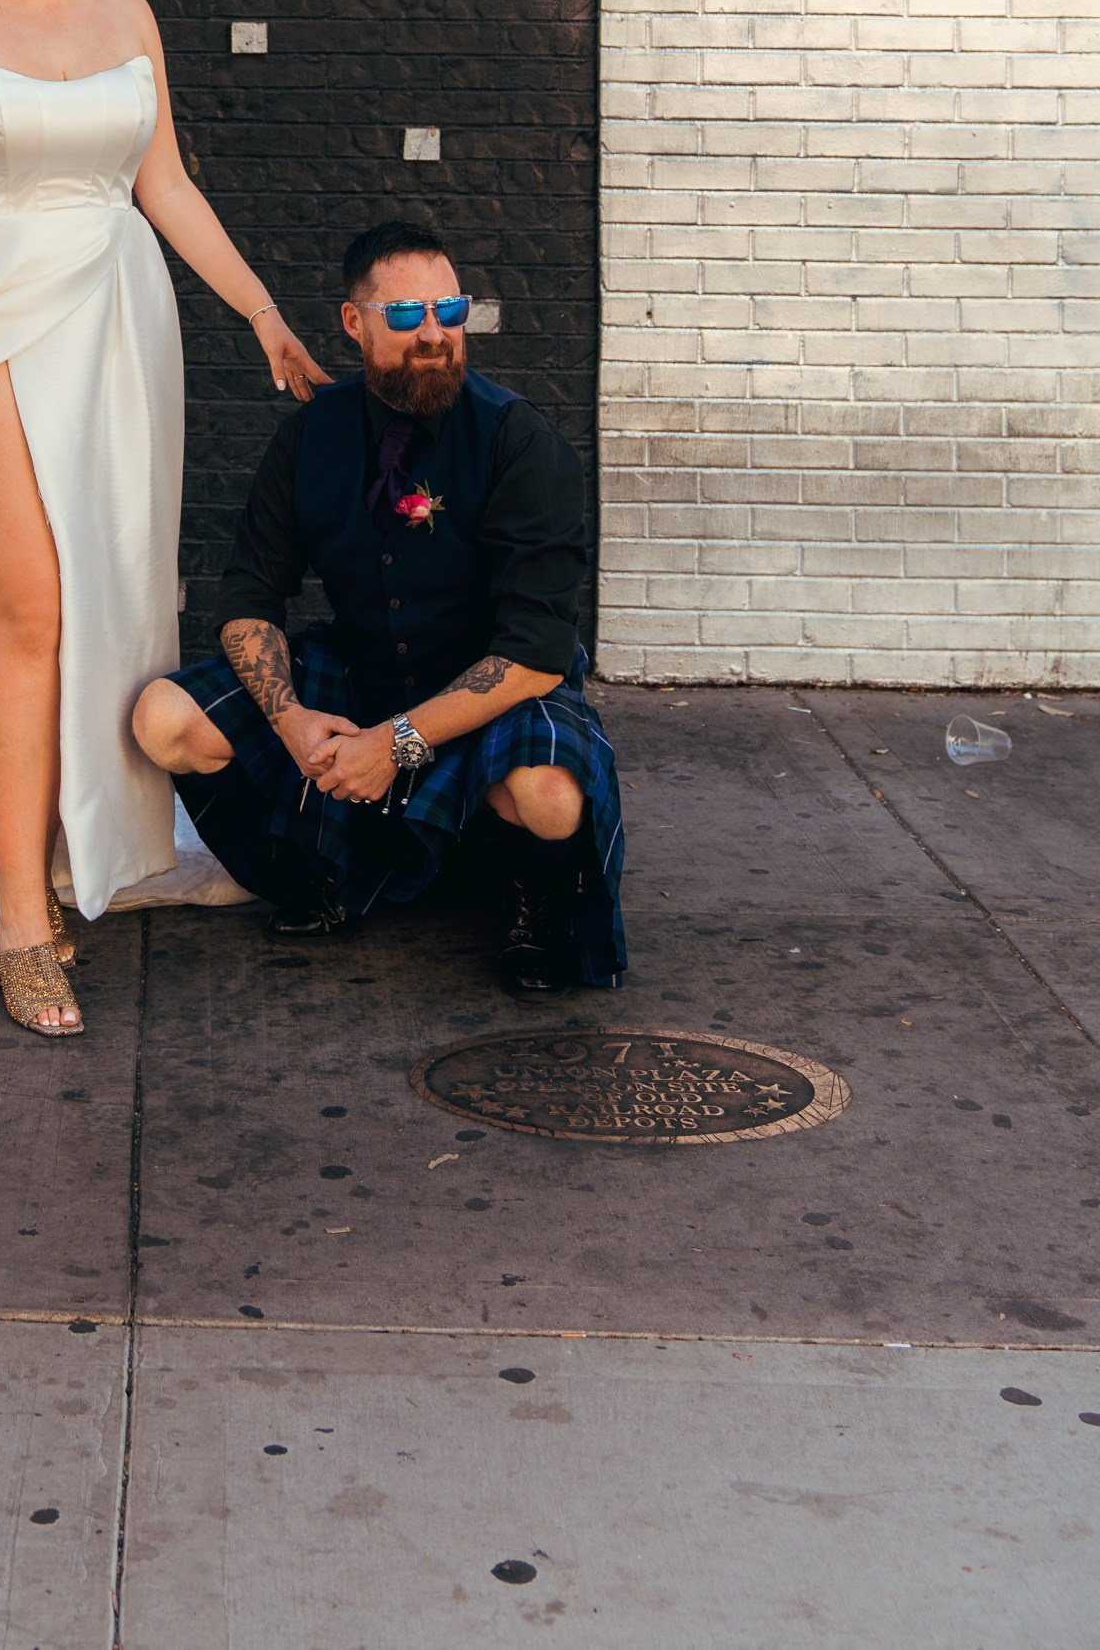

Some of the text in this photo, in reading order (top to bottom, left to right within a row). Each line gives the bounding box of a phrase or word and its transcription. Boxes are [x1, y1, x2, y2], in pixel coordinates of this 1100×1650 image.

[505, 1040, 679, 1065] 1971
[494, 1064, 755, 1082] UNION PLAZA
[610, 1081, 657, 1093] ON
[669, 1082, 742, 1094] SITE
[586, 1092, 703, 1103] OF OLD
[549, 1103, 726, 1117] RAILROAD
[566, 1116, 700, 1130] DEPOTS
